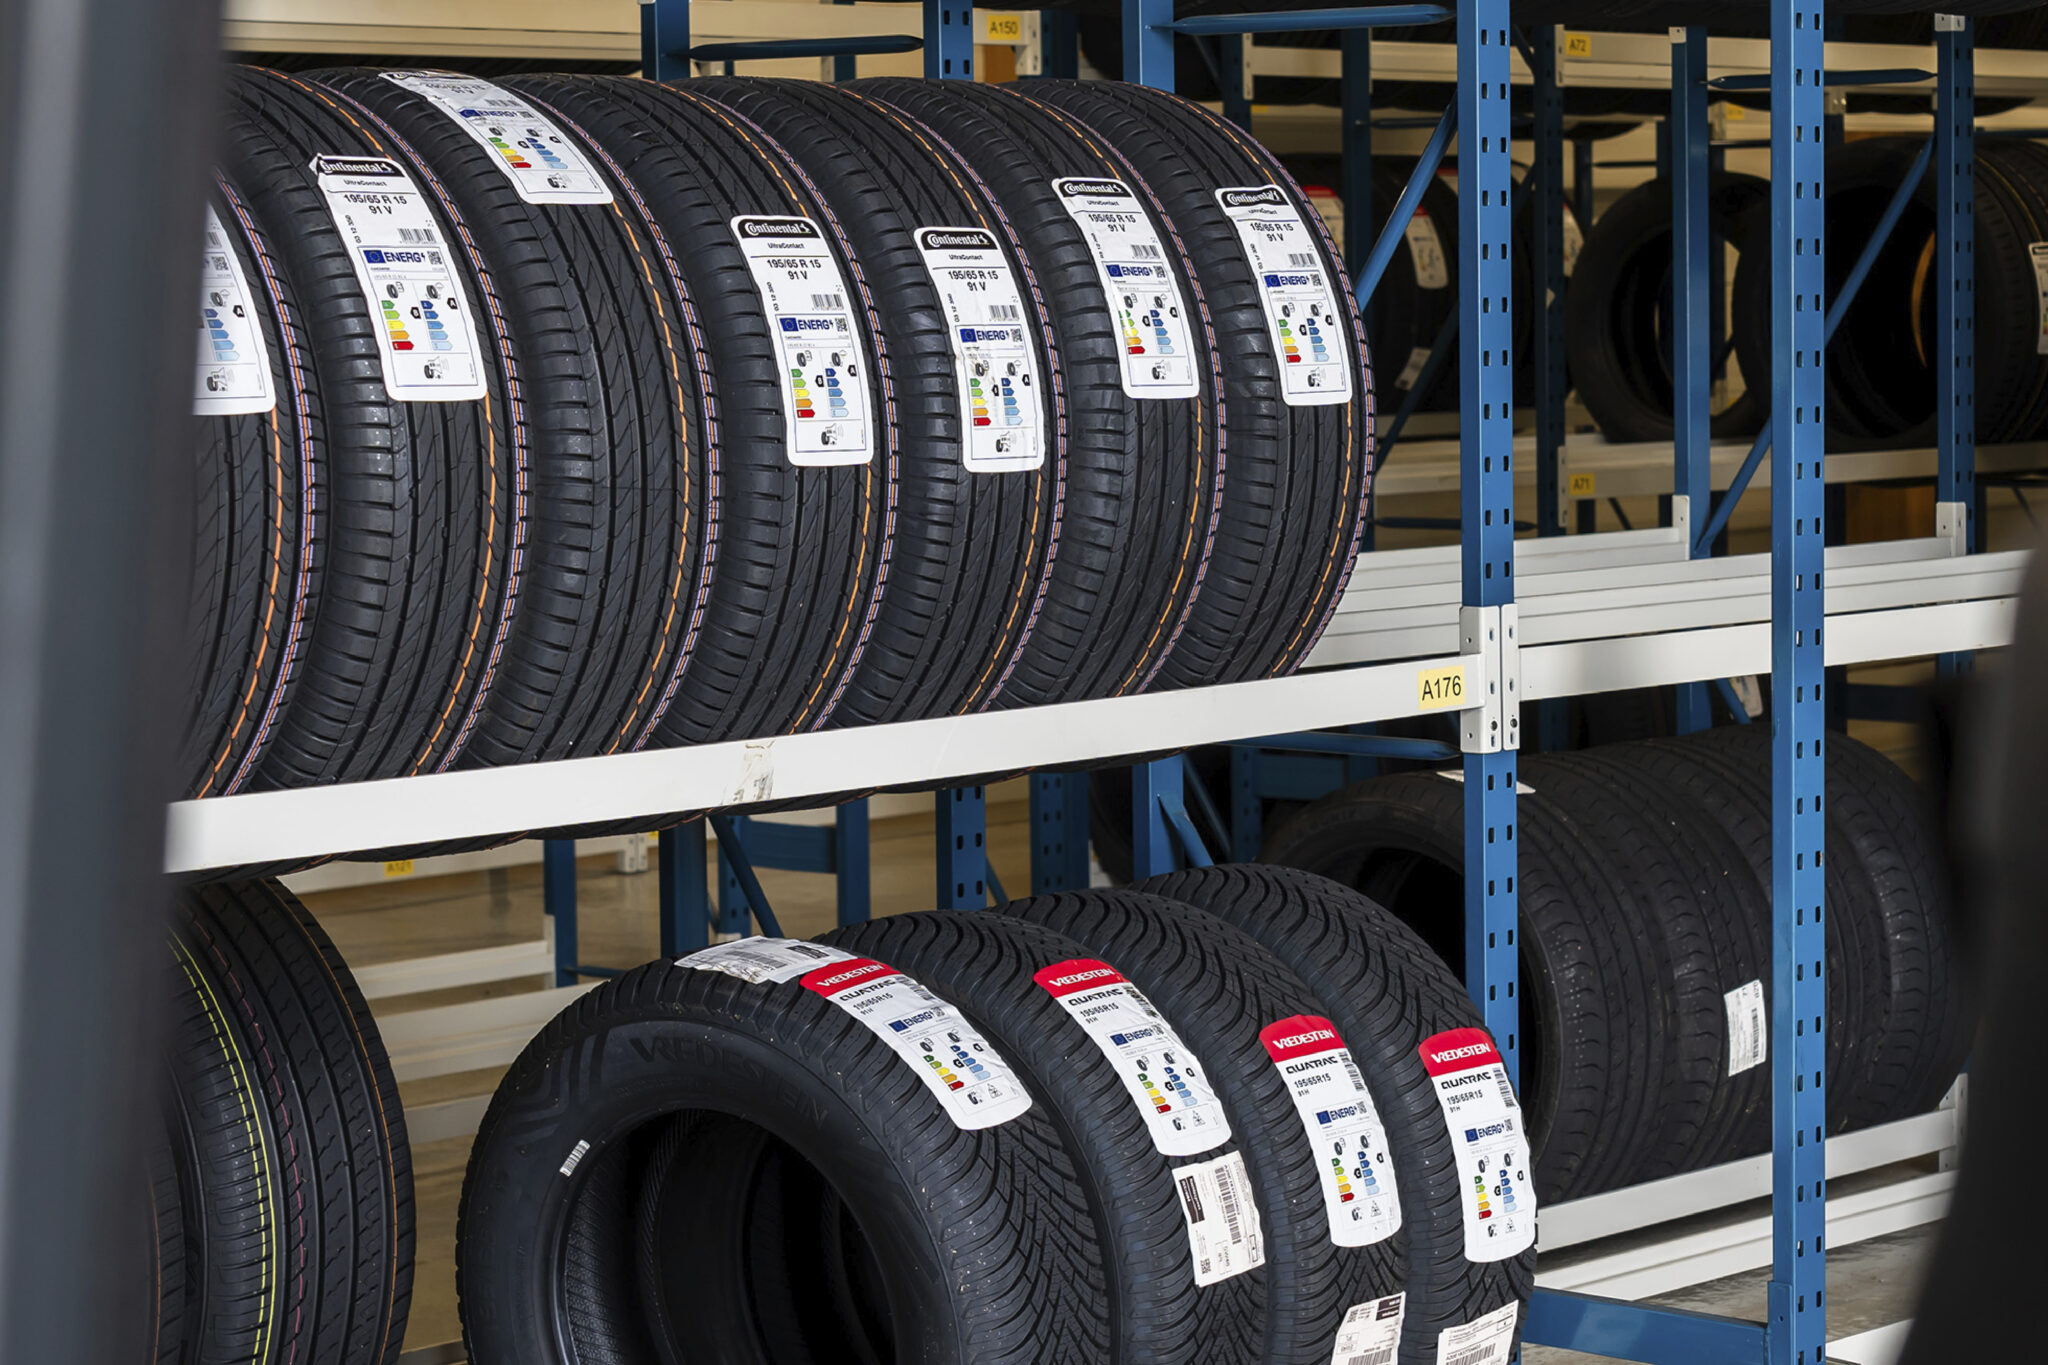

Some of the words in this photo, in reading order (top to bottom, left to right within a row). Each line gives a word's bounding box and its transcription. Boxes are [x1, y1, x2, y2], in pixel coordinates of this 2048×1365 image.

[989, 21, 1018, 35] A150
[1569, 38, 1587, 52] A72
[344, 179, 387, 187] UltraContact
[1063, 182, 1115, 194] Continental
[344, 194, 381, 204] 195/65
[383, 195, 392, 205] R
[395, 196, 408, 205] 15
[1226, 190, 1275, 205] Continental
[368, 205, 383, 214] 91
[384, 206, 393, 214] V
[1088, 213, 1116, 223] 195/65
[1117, 214, 1125, 223] R
[1126, 214, 1137, 224] 15
[744, 221, 801, 236] Continental
[1107, 224, 1119, 233] 91
[1119, 224, 1126, 233] V
[1250, 222, 1275, 232] 195/65
[1275, 223, 1283, 232] R
[1283, 223, 1294, 232] 15
[927, 233, 981, 248] Continental
[1266, 233, 1277, 242] 91
[1277, 233, 1284, 242] V
[767, 259, 798, 268] 195/65
[800, 259, 809, 268] R
[810, 259, 821, 269] 15
[788, 270, 800, 280] 91
[800, 271, 808, 280] V
[948, 270, 978, 280] 195/65
[979, 270, 987, 280] R
[987, 270, 999, 280] 15
[967, 282, 978, 292] 91
[979, 282, 987, 291] V
[1422, 675, 1462, 701] A176
[816, 964, 886, 987] VREDESTEIN
[1048, 968, 1116, 987] VREDESTEIN
[839, 978, 897, 1001] QUATRAC
[1068, 988, 1124, 1006] QUATRAC
[1272, 1028, 1335, 1049] VREDESTEIN
[1430, 1043, 1491, 1064] VREDESTEIN
[1285, 1056, 1339, 1075] QUATRAC
[1440, 1071, 1492, 1090] QUATRAC
